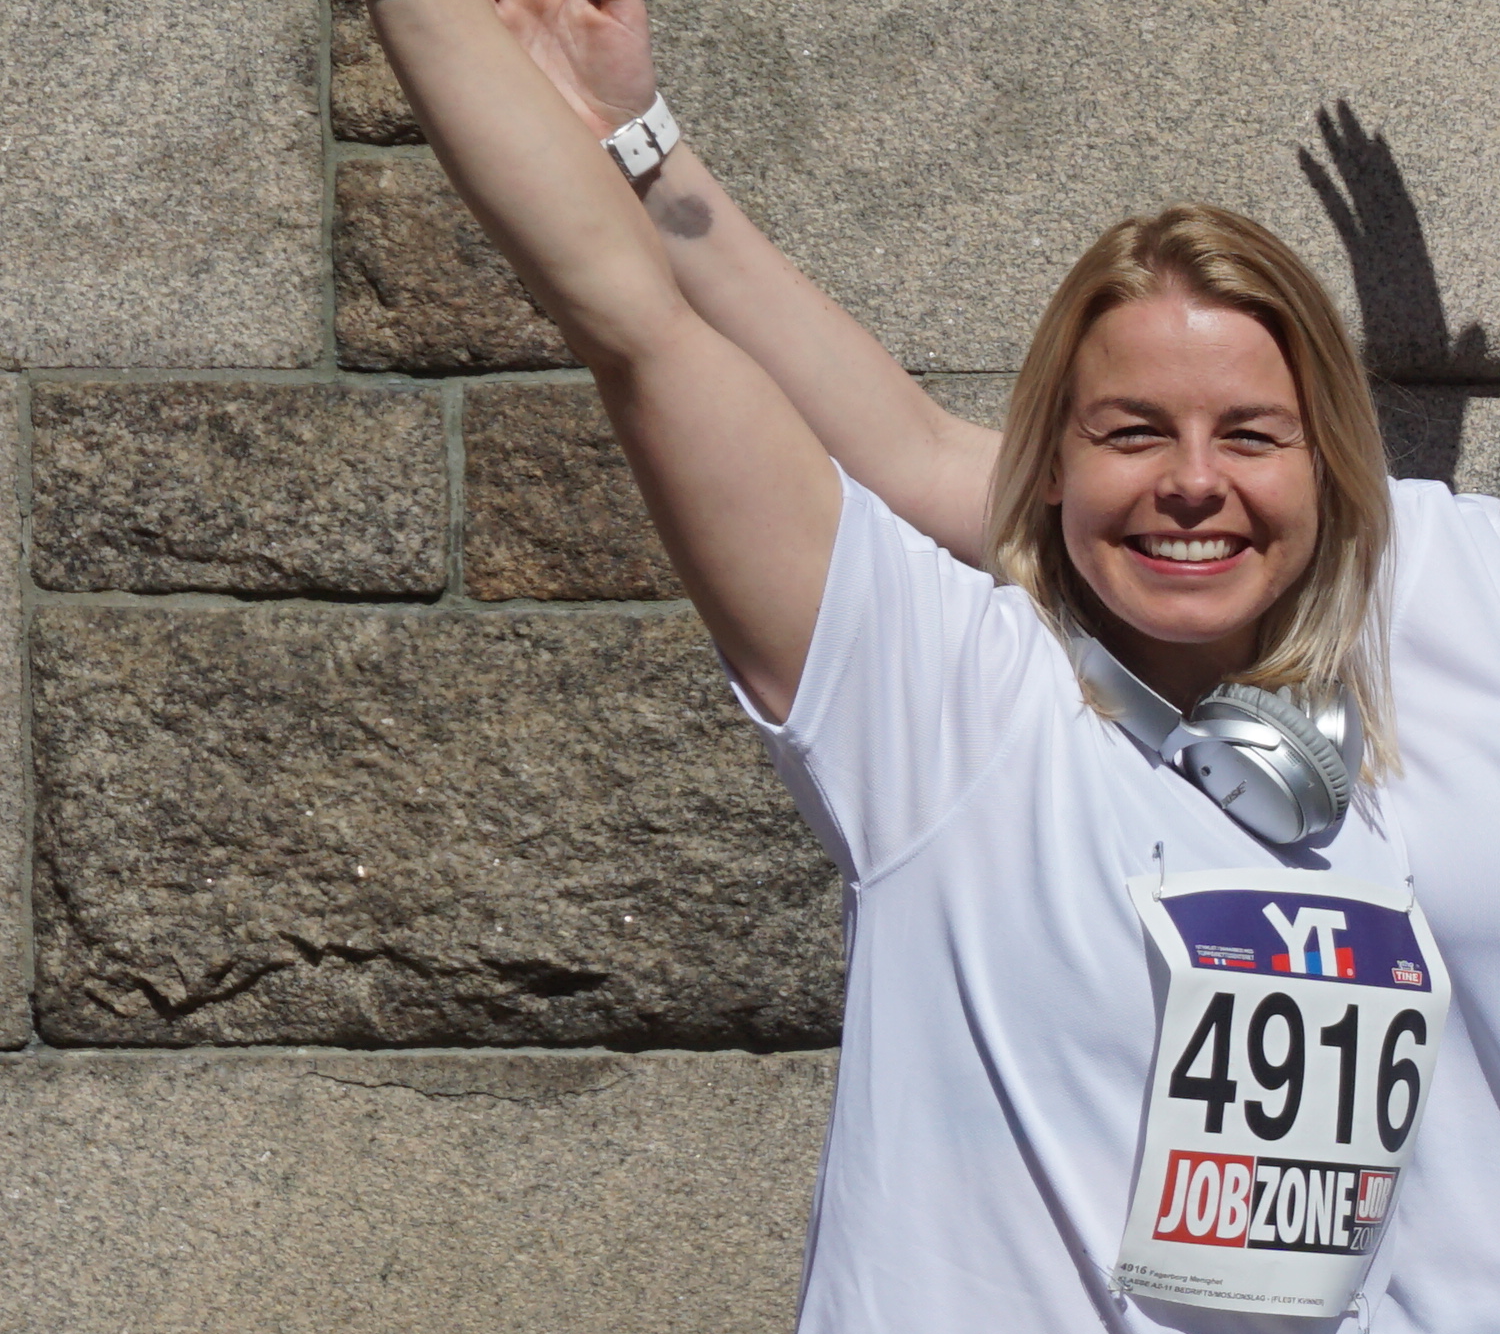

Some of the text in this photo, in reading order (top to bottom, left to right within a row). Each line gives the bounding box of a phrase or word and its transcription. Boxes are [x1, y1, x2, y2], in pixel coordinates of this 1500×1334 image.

[1262, 901, 1348, 977] YT
[1395, 970, 1420, 983] TINE
[1168, 991, 1427, 1153] 4916
[1359, 1175, 1393, 1219] JOB
[1120, 1262, 1147, 1275] 4916
